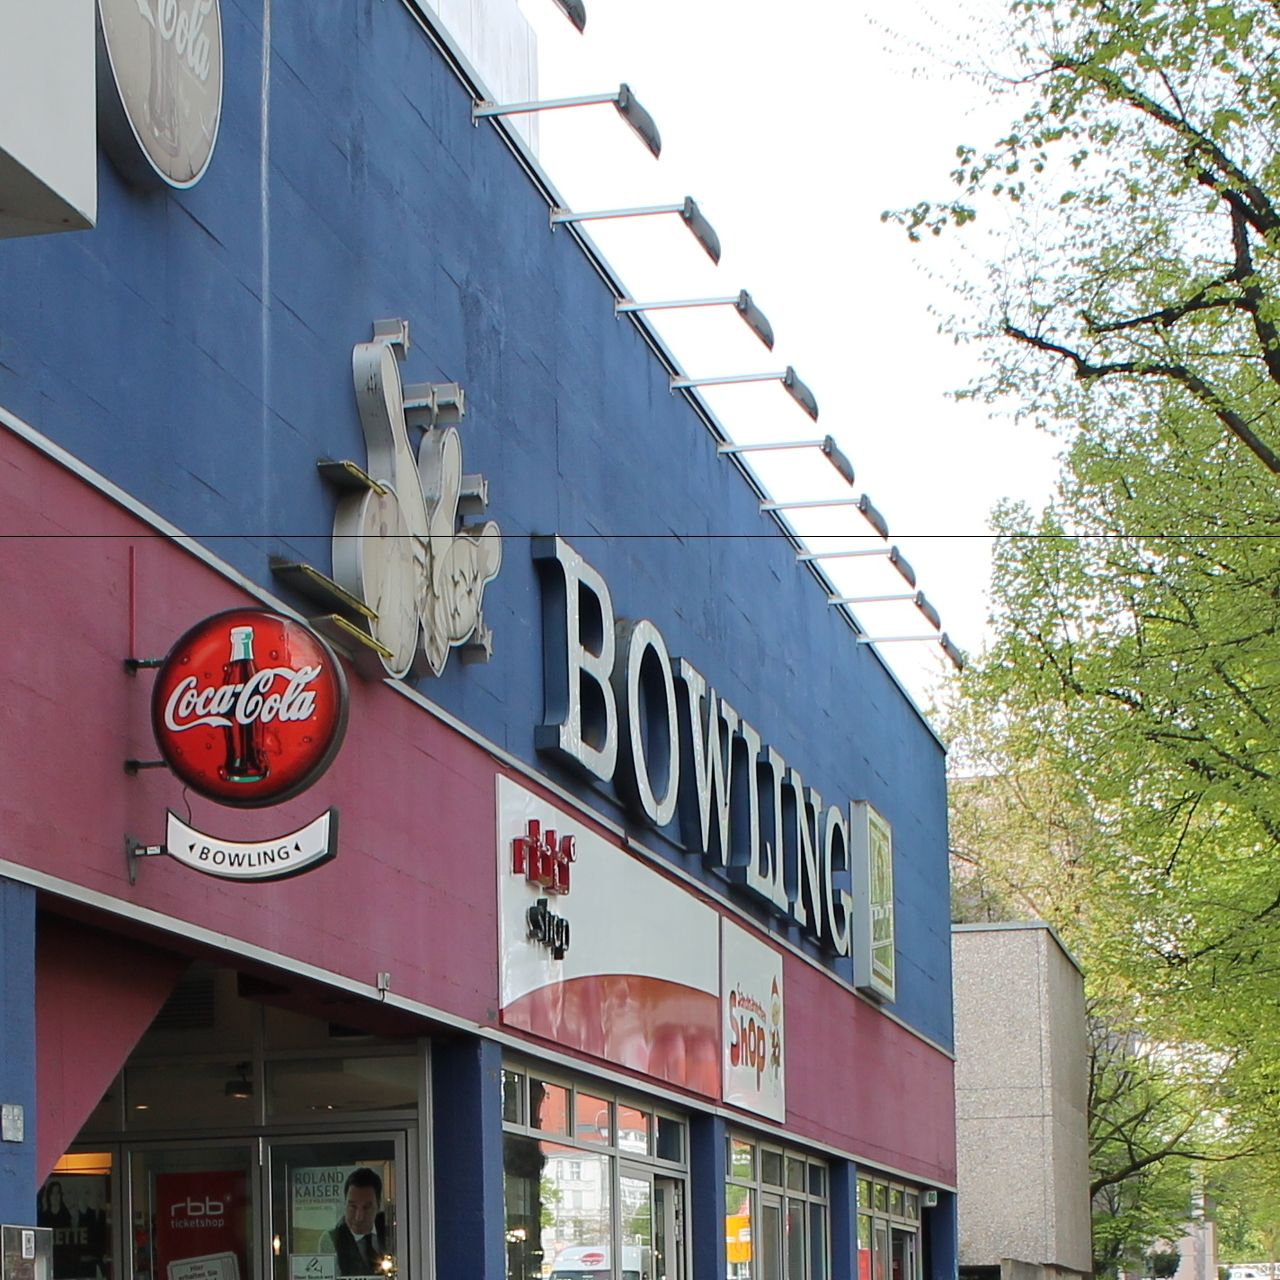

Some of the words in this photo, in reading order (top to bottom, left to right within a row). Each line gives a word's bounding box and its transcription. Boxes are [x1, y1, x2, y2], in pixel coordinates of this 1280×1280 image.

[164, 664, 322, 731] Coca-Cola
[535, 533, 852, 957] BOWLING
[198, 844, 292, 867] BOWLING
[294, 1171, 345, 1185] ROLAND
[294, 1184, 340, 1198] KAISER
[170, 1196, 224, 1217] rbb
[171, 1217, 225, 1229] ticketshop
